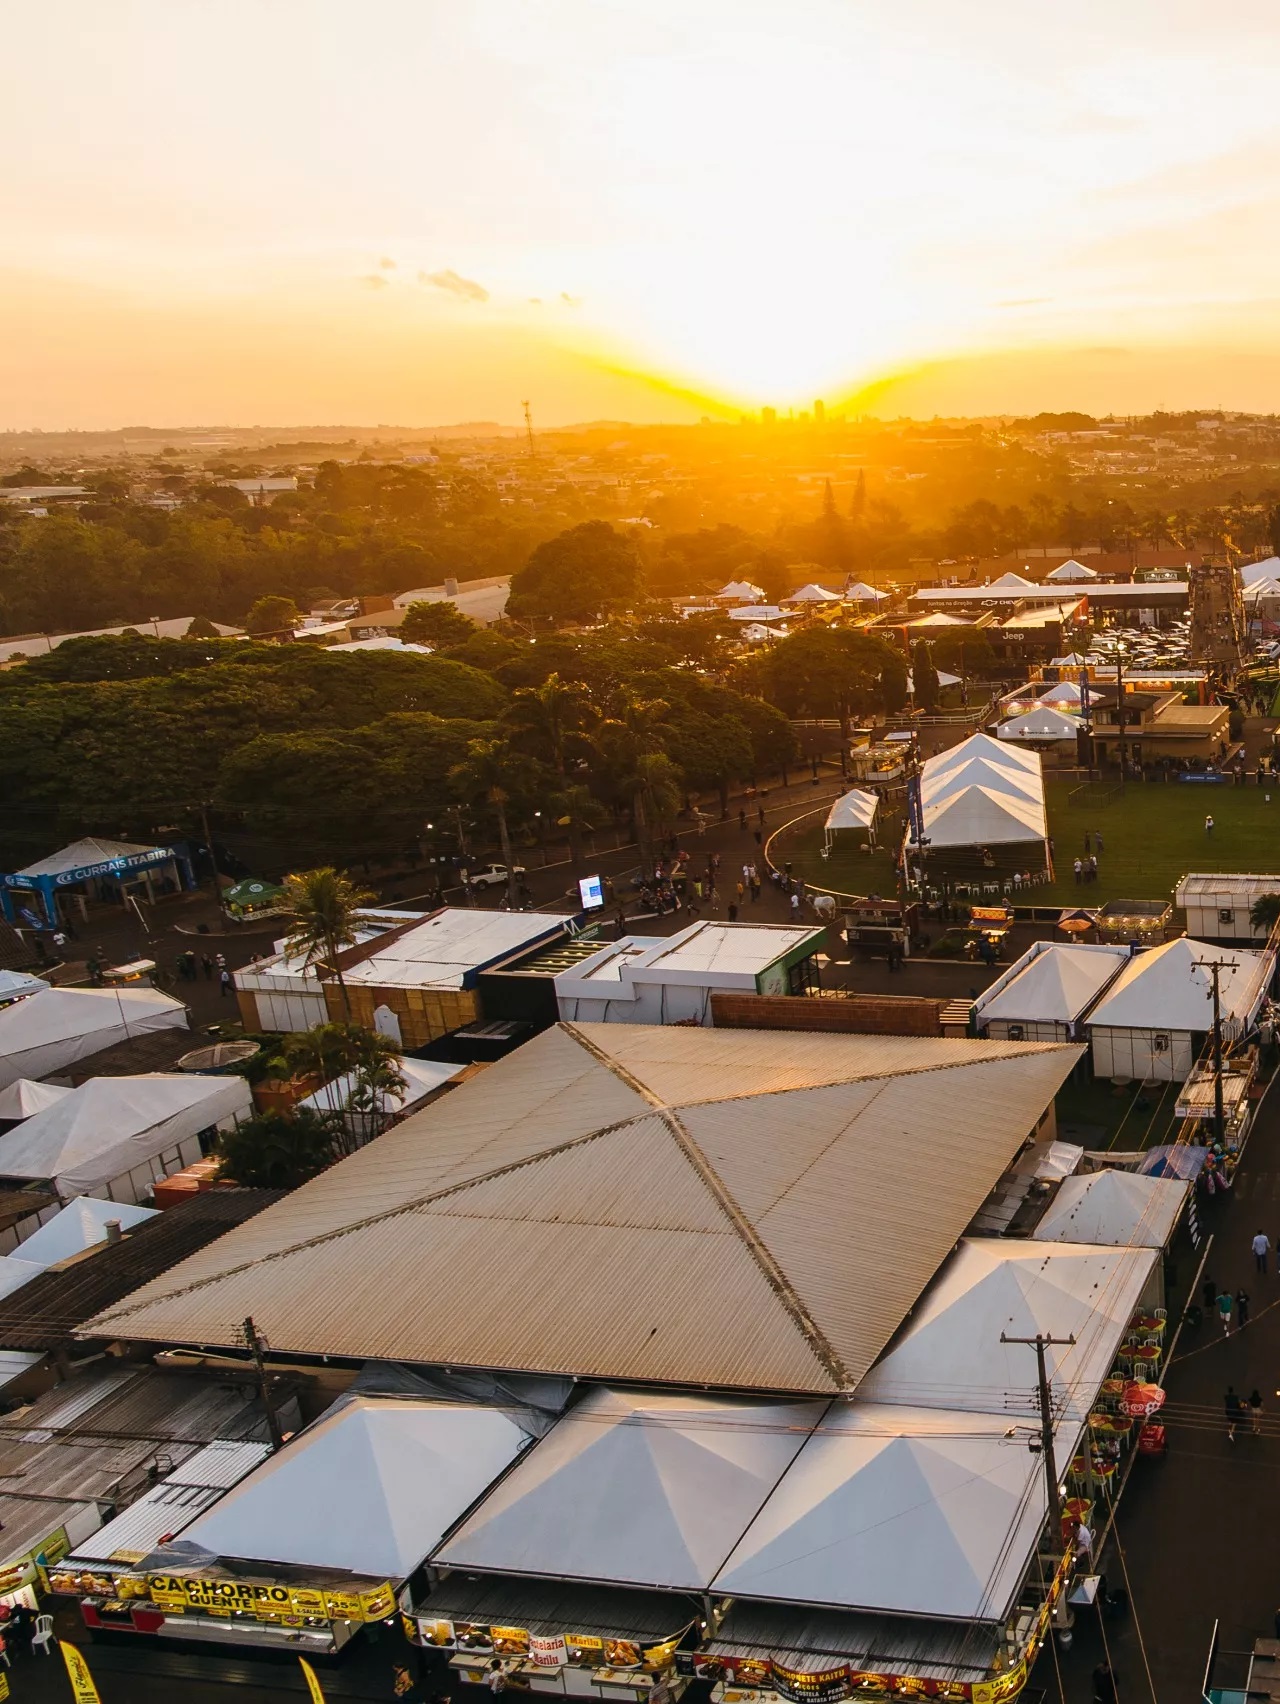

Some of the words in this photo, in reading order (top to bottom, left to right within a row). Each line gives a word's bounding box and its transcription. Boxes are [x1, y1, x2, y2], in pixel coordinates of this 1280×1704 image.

[1002, 631, 1025, 641] Jeep
[75, 859, 127, 880] CURRAIS
[127, 847, 176, 867] ITABIRA
[151, 1577, 288, 1602] CACHORRO
[189, 1594, 251, 1609] QUENTE
[492, 1628, 527, 1639] Pastelaria
[570, 1636, 599, 1646] Marilu
[819, 1669, 845, 1682] KAITU
